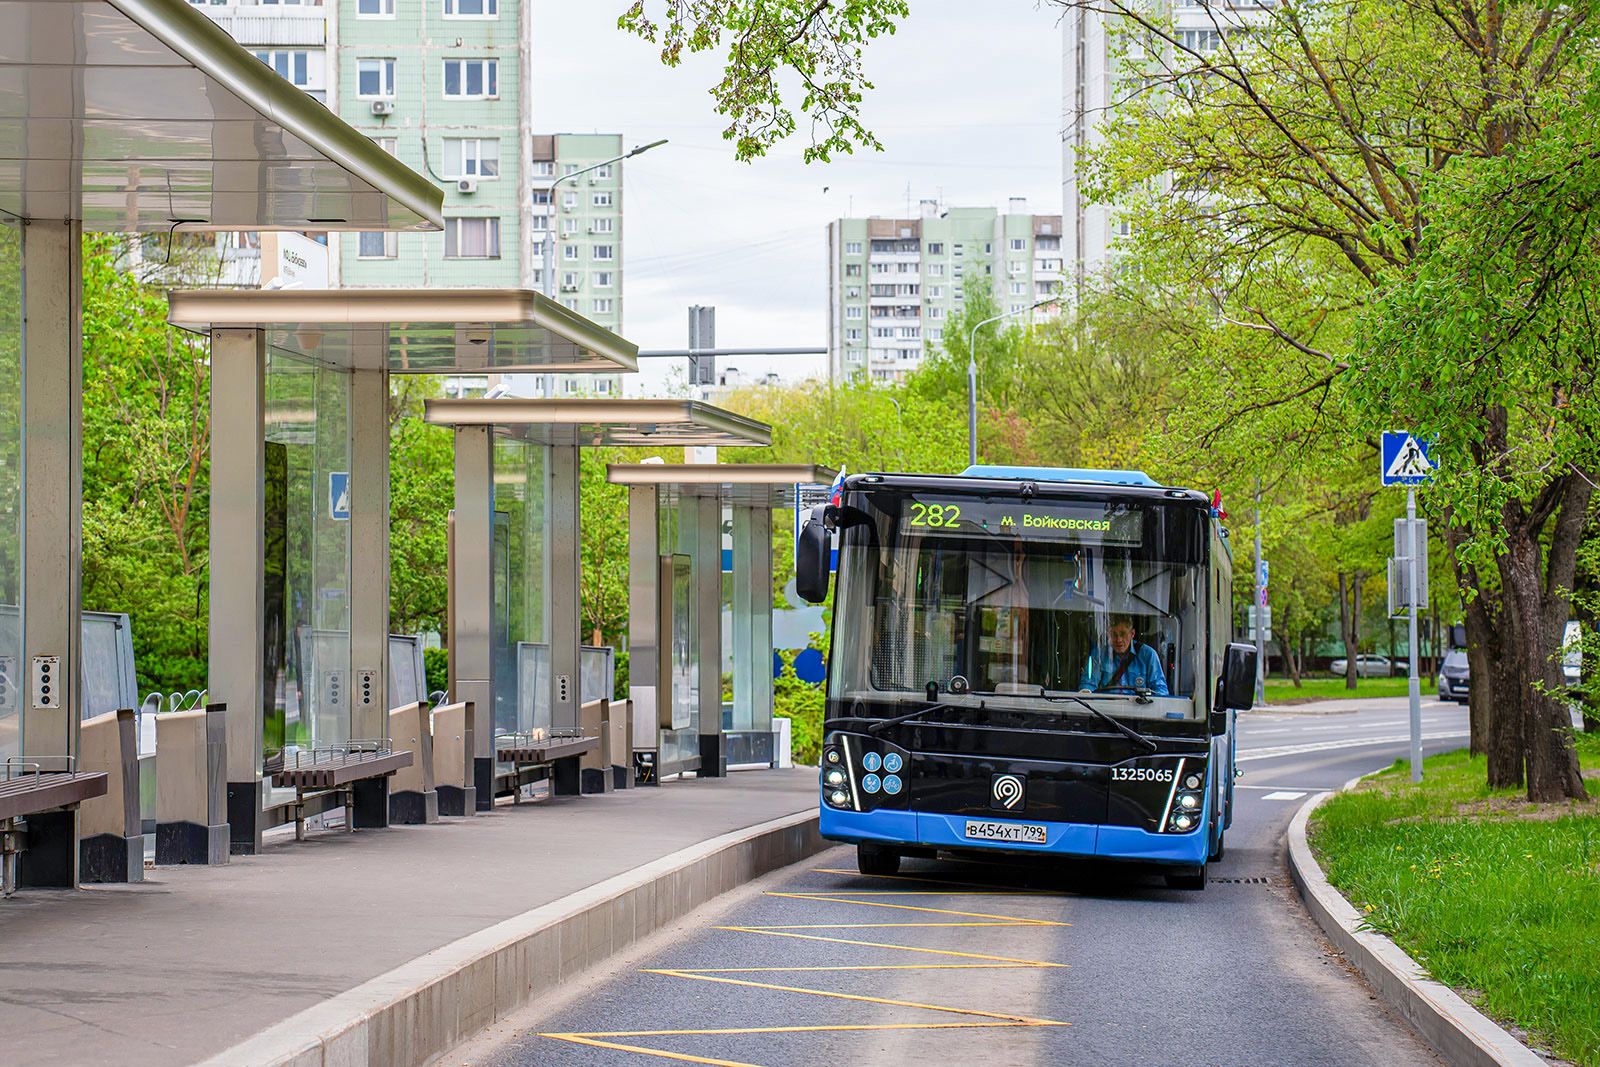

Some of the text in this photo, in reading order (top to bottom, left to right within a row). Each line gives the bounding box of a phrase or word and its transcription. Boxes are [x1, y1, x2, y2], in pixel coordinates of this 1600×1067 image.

[911, 503, 961, 528] 282
[1023, 514, 1110, 531] Войковская
[1111, 768, 1173, 782] 1325065
[1023, 826, 1043, 837] 799
